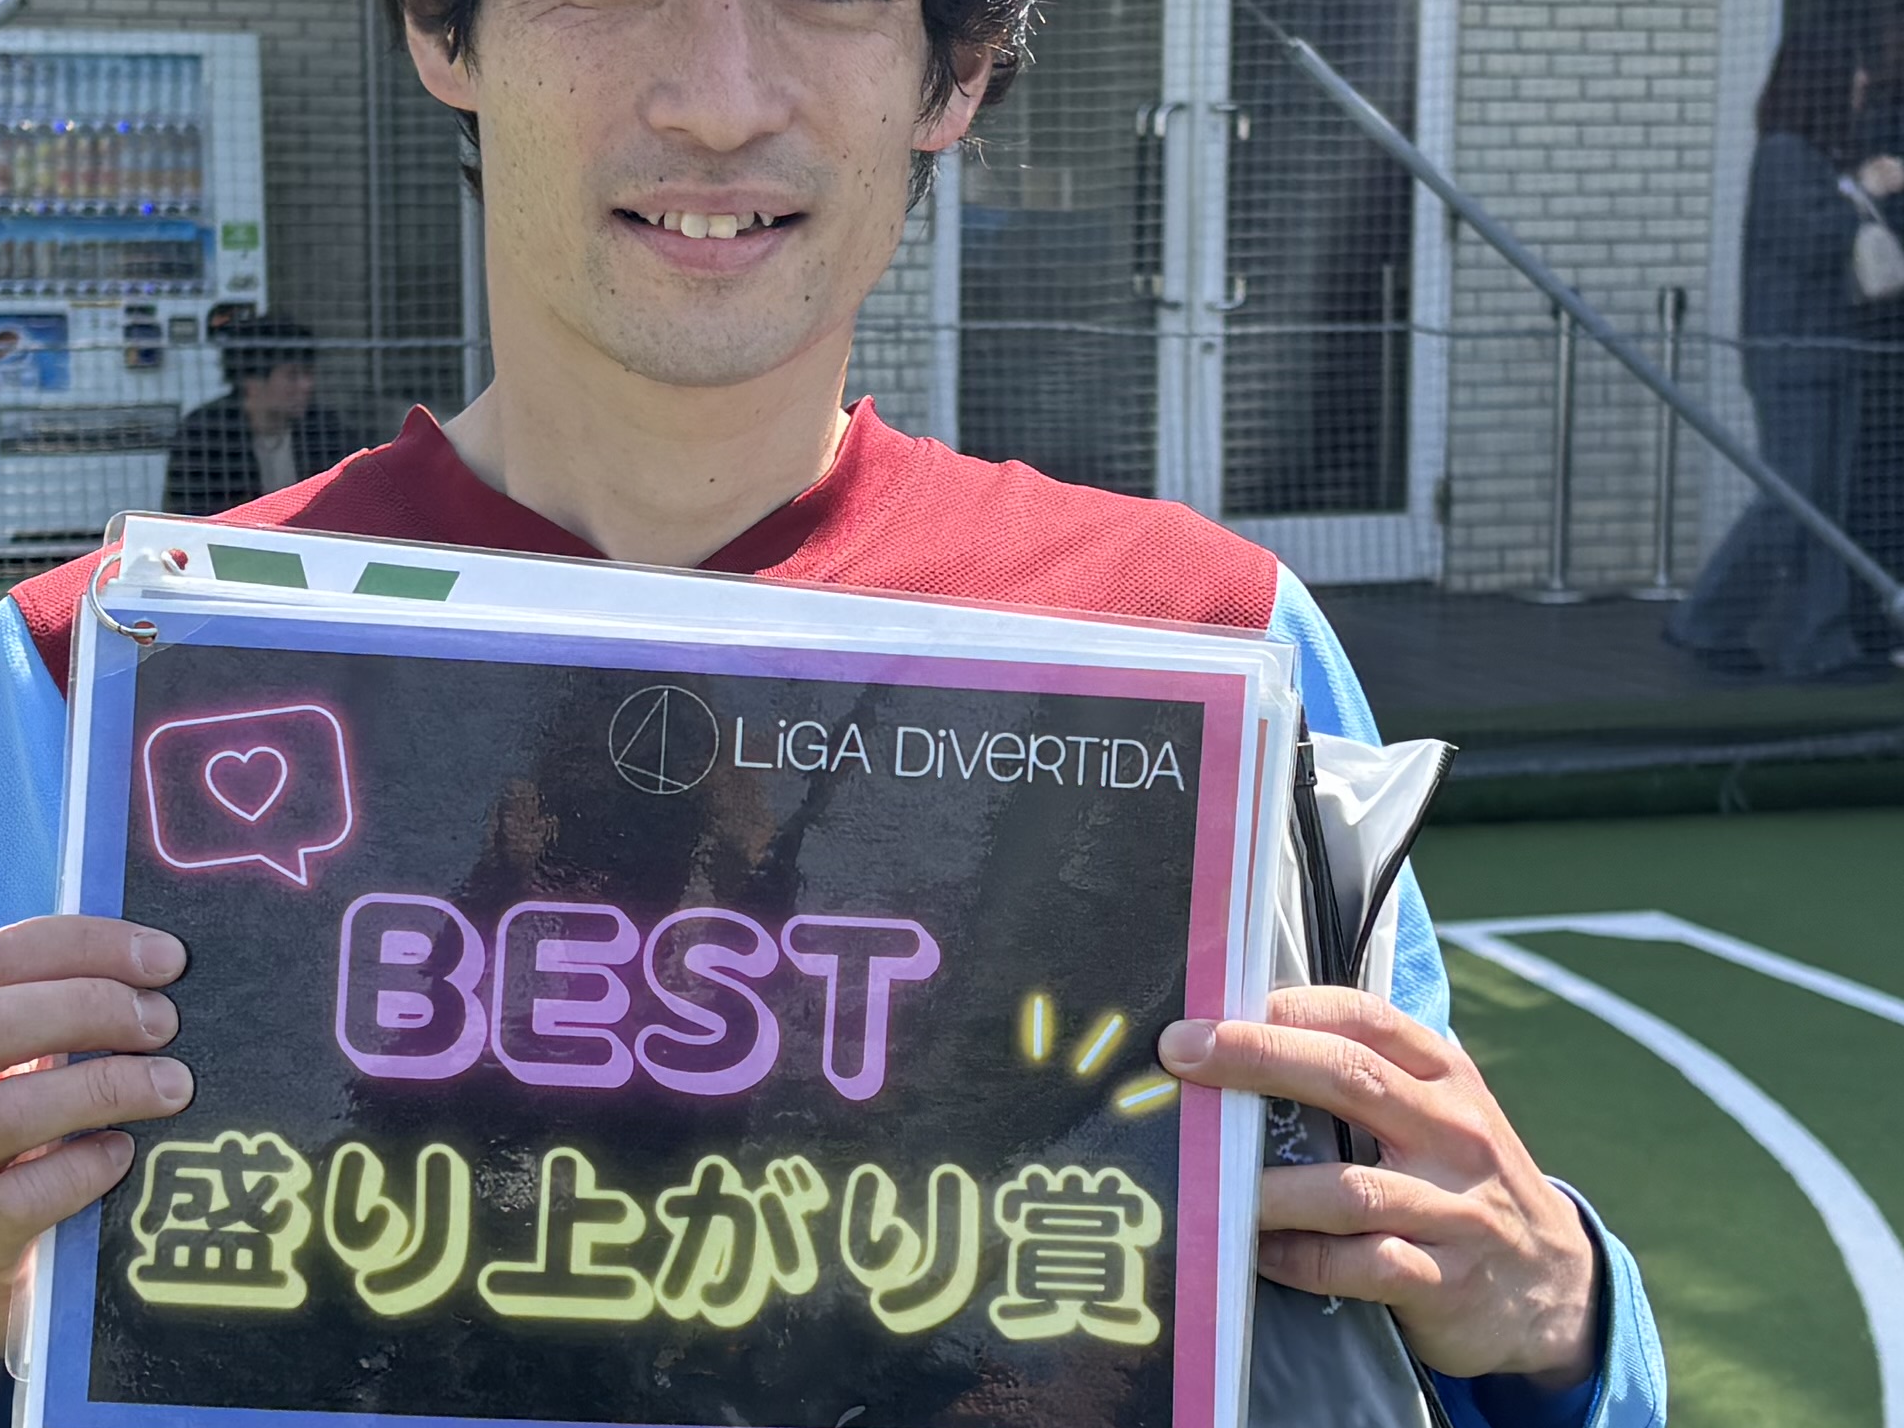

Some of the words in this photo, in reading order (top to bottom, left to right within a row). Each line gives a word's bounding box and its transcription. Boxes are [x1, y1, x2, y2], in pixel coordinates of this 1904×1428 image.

[335, 892, 941, 1101] BEST
[127, 1130, 1161, 1345] 盛り上がり賞
